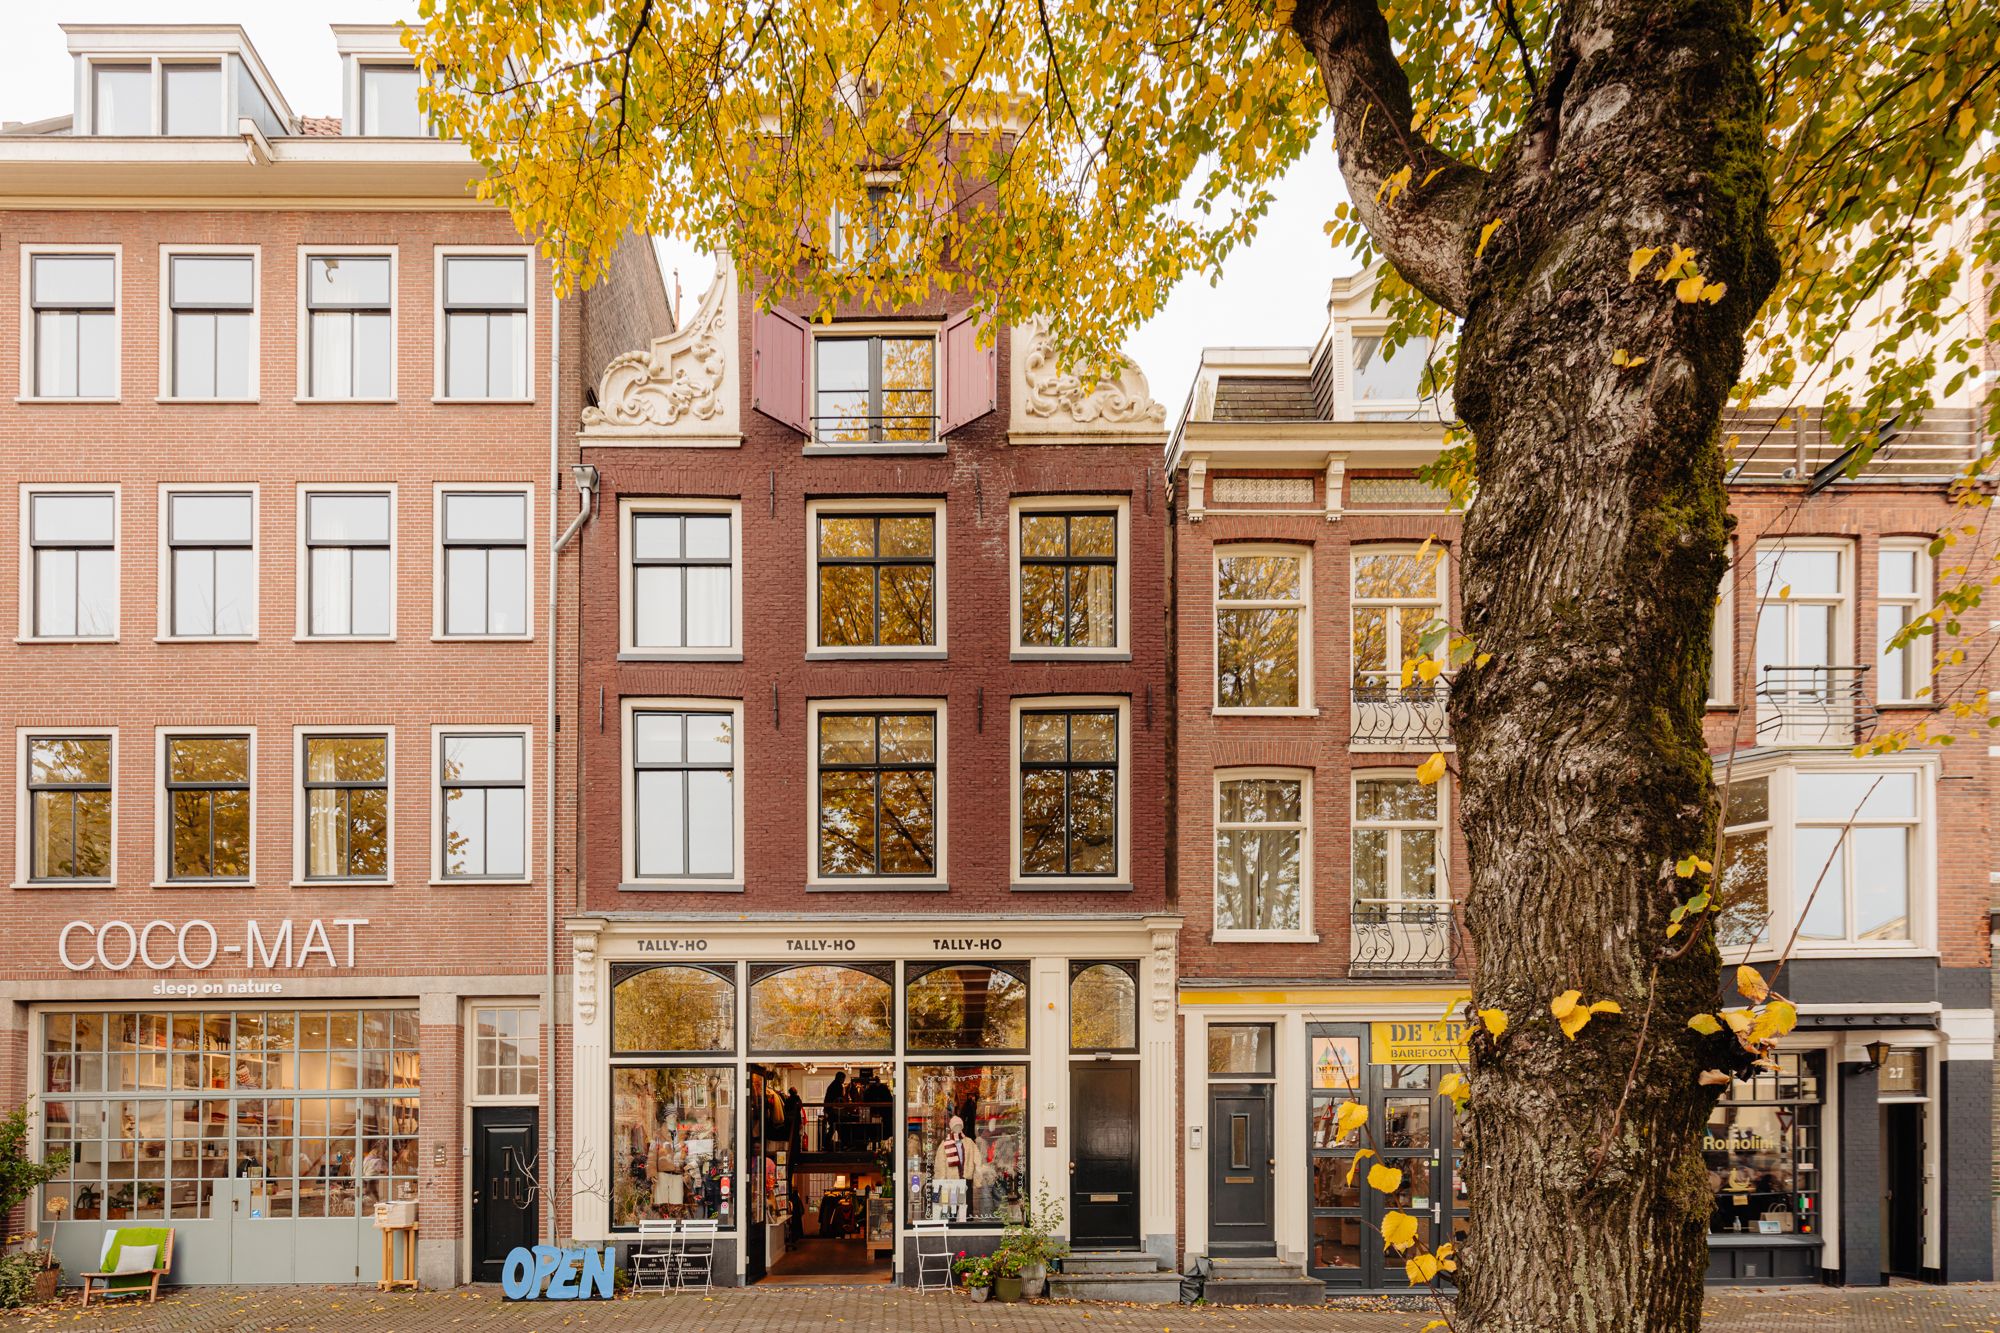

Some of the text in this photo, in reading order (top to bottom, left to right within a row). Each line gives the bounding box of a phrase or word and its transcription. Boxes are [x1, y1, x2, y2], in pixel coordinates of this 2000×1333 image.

[58, 919, 369, 971] COCO-MAT
[637, 939, 708, 951] TALLY-HO
[786, 939, 856, 951] TALLY-HO
[932, 938, 1002, 950] TALLY-HO
[152, 980, 282, 998] sleep on nature
[1391, 1024, 1467, 1042] DE TR
[1391, 1048, 1455, 1058] BAREFOOT
[1889, 1067, 1904, 1079] 27
[1703, 1135, 1774, 1150] Romolini
[502, 1245, 616, 1300] OPEN
